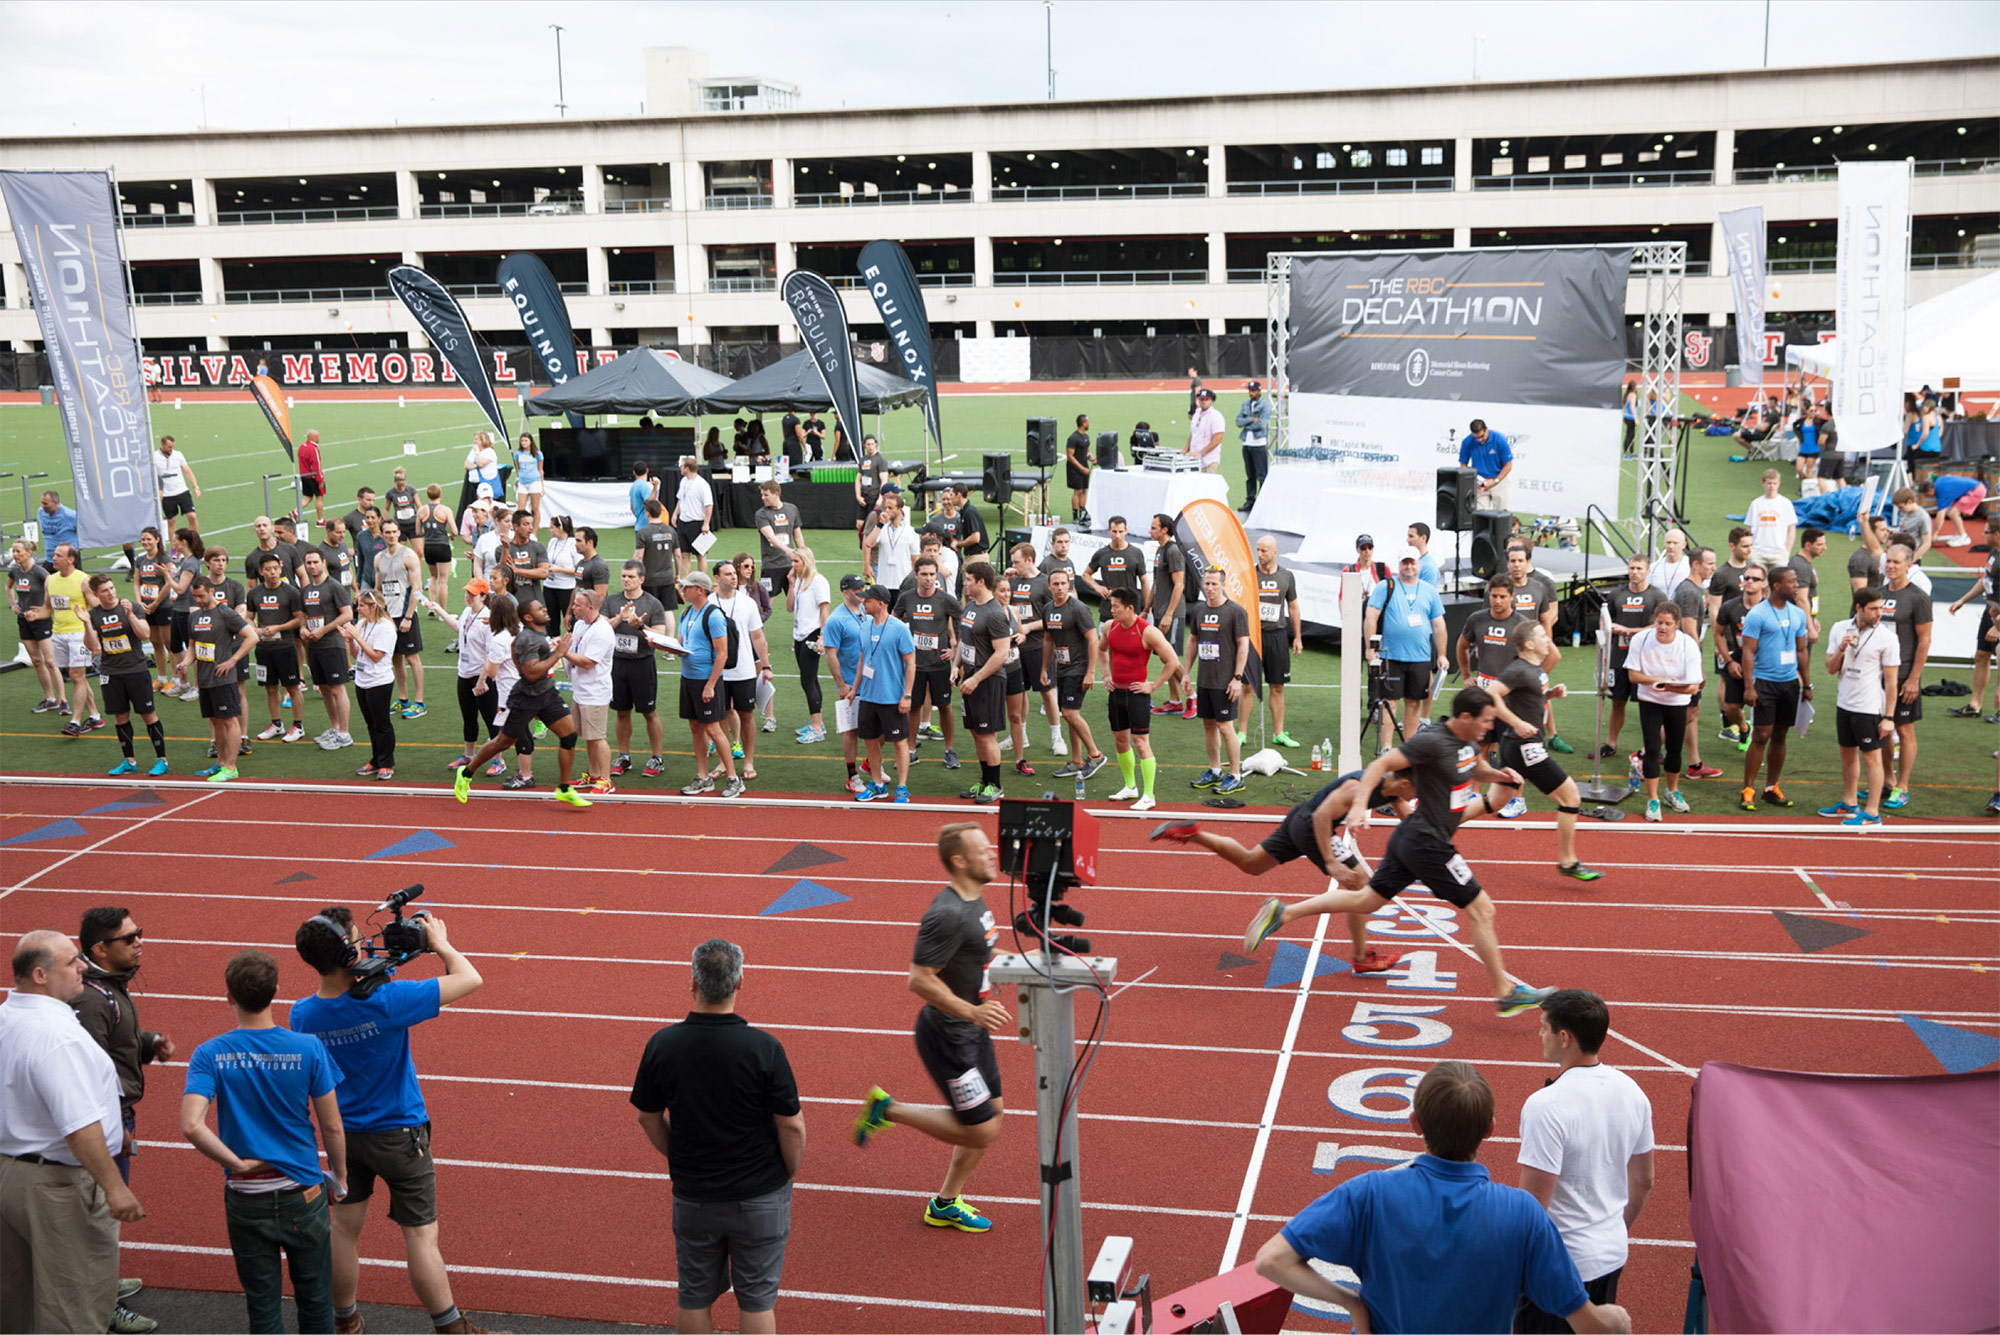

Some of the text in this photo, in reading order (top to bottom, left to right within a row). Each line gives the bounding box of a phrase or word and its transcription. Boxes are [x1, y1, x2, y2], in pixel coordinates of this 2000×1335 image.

[1369, 277, 1446, 295] THE RBC
[505, 277, 569, 385] EQUINOX
[791, 289, 839, 373] RESULTS
[865, 264, 926, 382] EQUINOX
[142, 355, 252, 386] SILVA
[283, 351, 516, 384] MEMORIL
[1518, 478, 1564, 493] KRUG
[917, 604, 932, 613] 10
[1341, 1001, 1453, 1049] 5
[215, 1061, 302, 1071] INTERNATIONAL
[248, 1052, 302, 1062] PRODUCTIONS
[1327, 1066, 1427, 1124] 6
